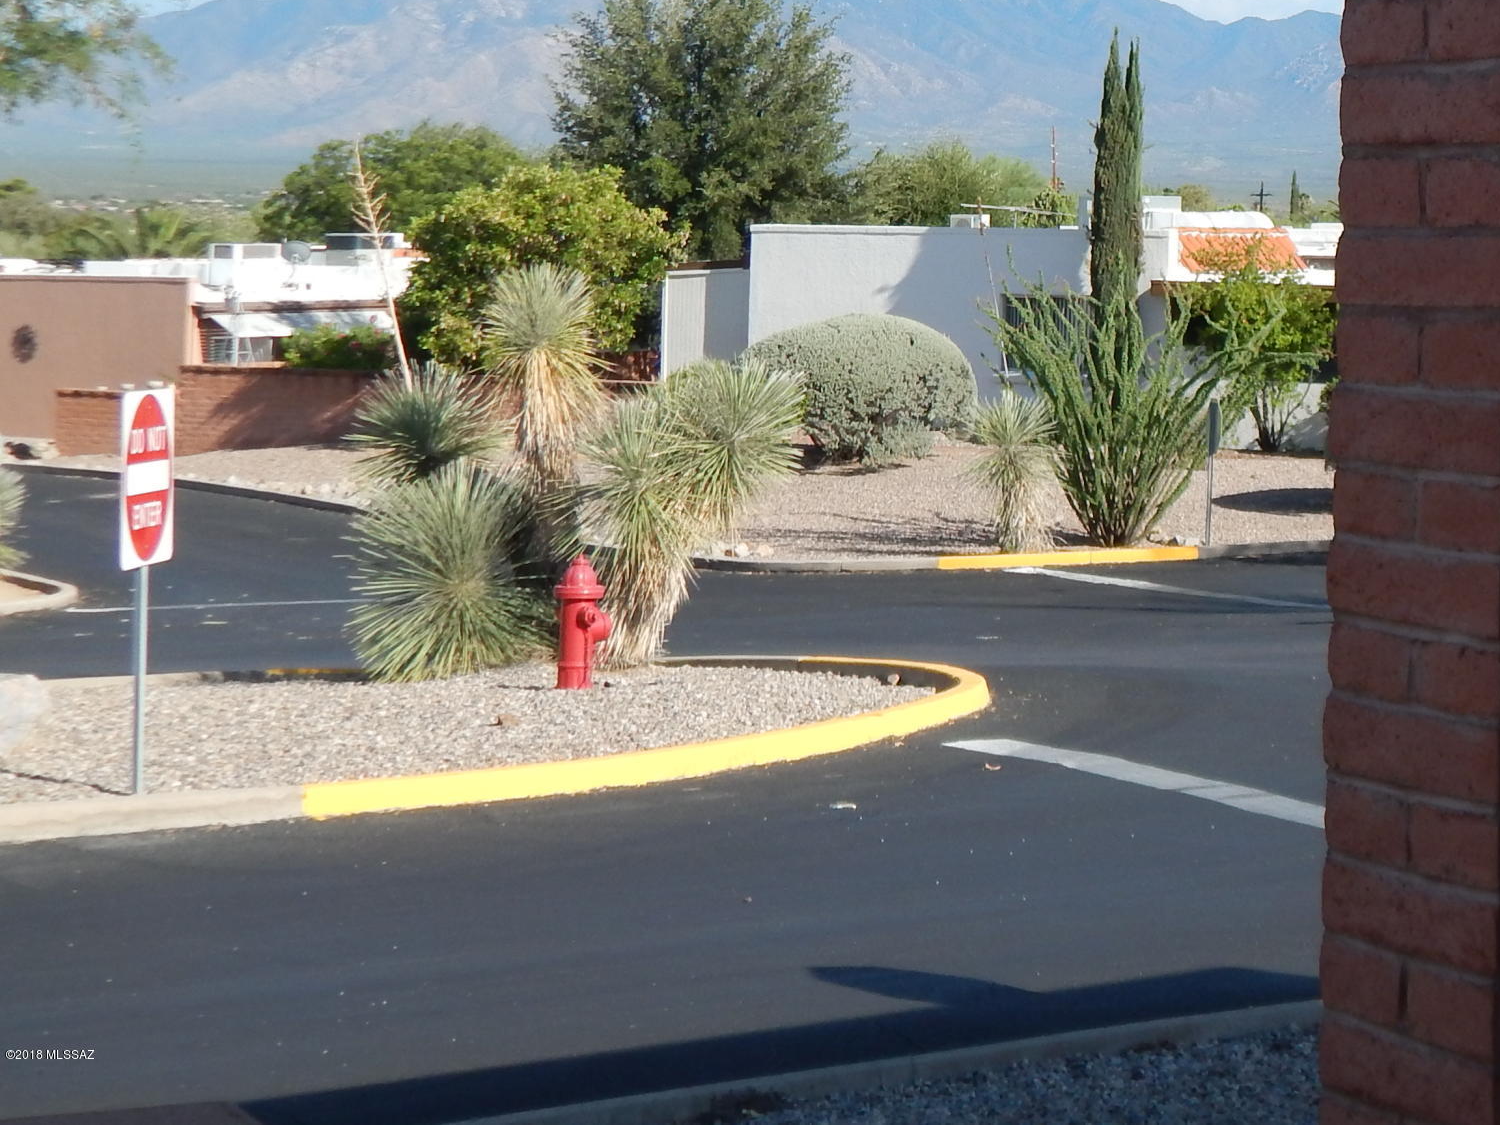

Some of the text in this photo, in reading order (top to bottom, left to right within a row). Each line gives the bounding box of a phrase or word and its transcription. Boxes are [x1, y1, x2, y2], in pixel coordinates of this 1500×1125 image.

[130, 426, 166, 454] DO NOT
[132, 501, 162, 530] ENTER
